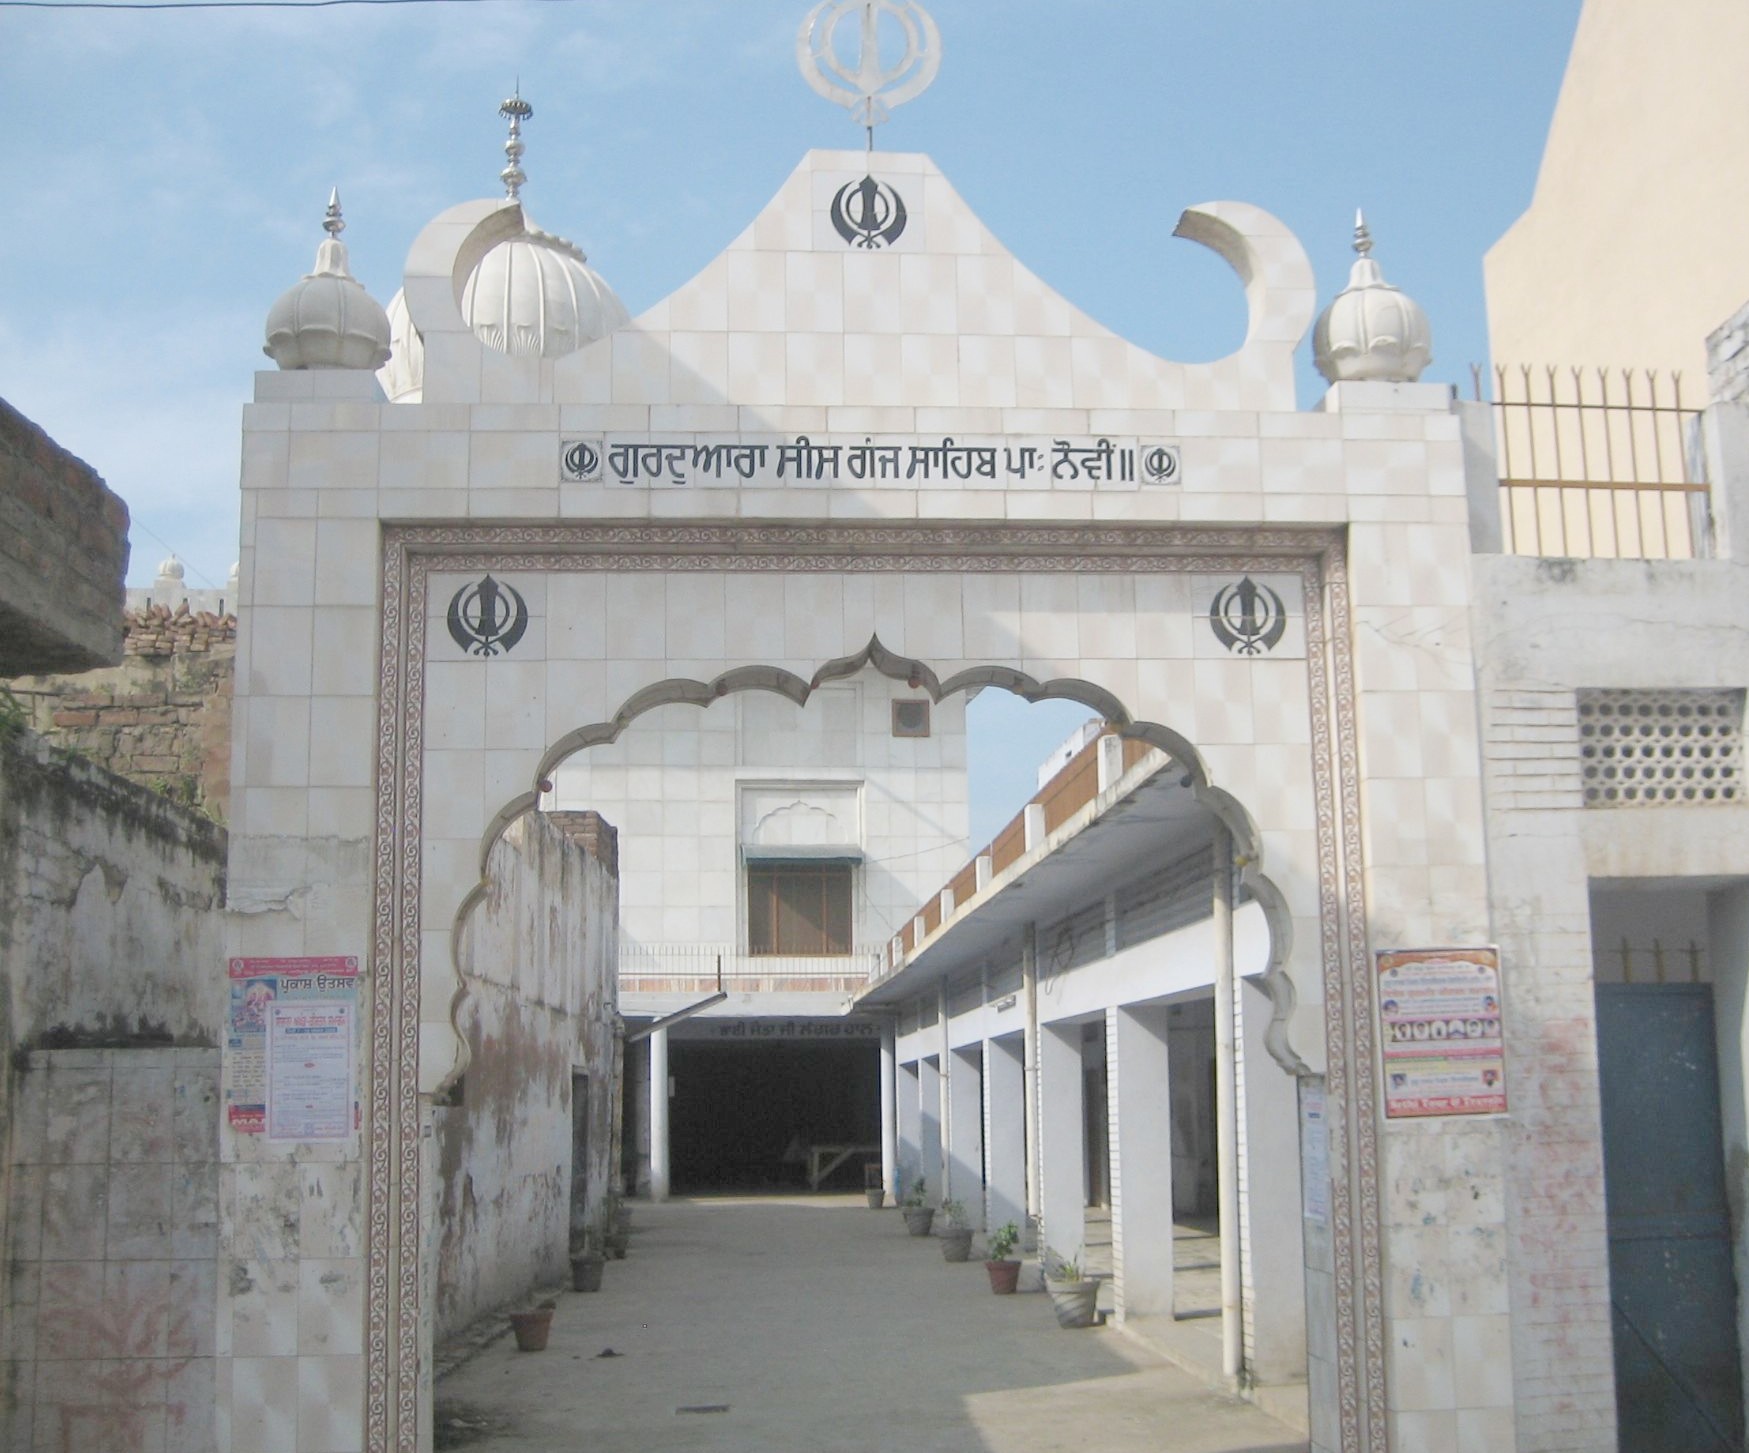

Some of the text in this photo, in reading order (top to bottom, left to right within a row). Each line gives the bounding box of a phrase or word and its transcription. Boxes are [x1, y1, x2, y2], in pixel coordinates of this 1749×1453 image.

[607, 443, 770, 485] ਗੁਰਦੁਆਰਾ
[775, 435, 843, 480] ਸੀਸ
[847, 437, 902, 479] ਗੰਜ
[906, 437, 998, 480] ਸਾਹਿਬ
